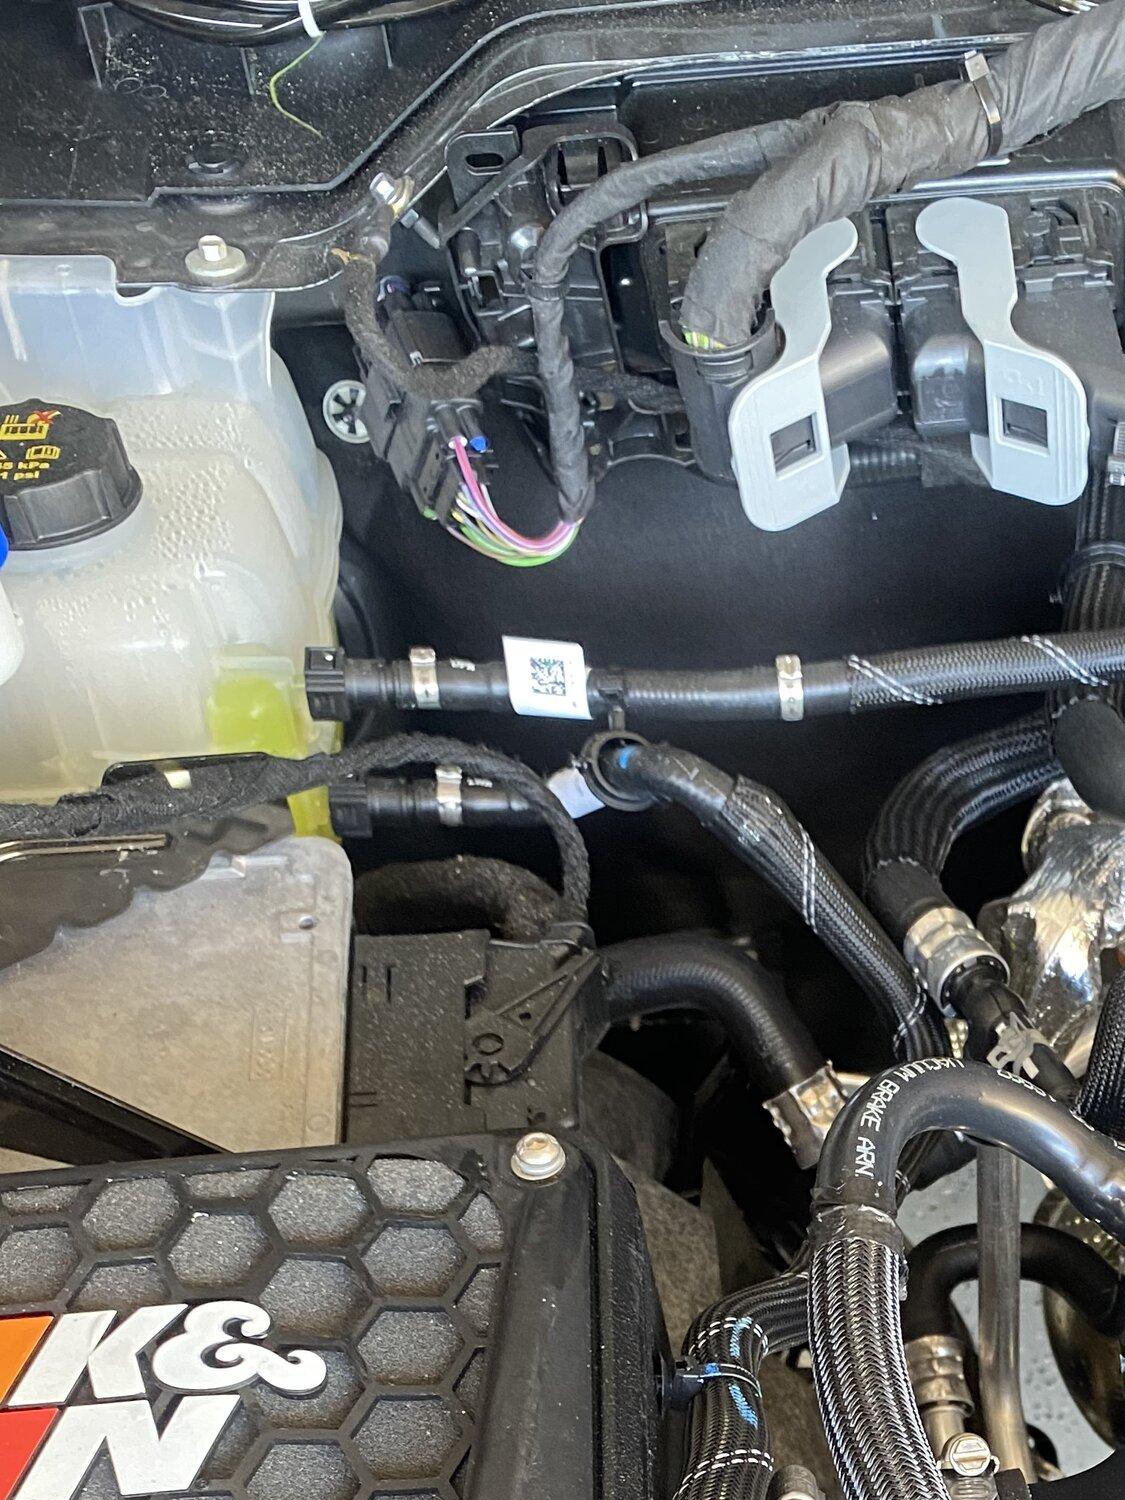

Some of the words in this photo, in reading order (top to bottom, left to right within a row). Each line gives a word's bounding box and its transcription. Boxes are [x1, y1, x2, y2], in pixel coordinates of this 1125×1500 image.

[17, 461, 50, 470] kPa
[860, 1078, 900, 1132] BRAKE
[854, 1136, 877, 1178] ARN
